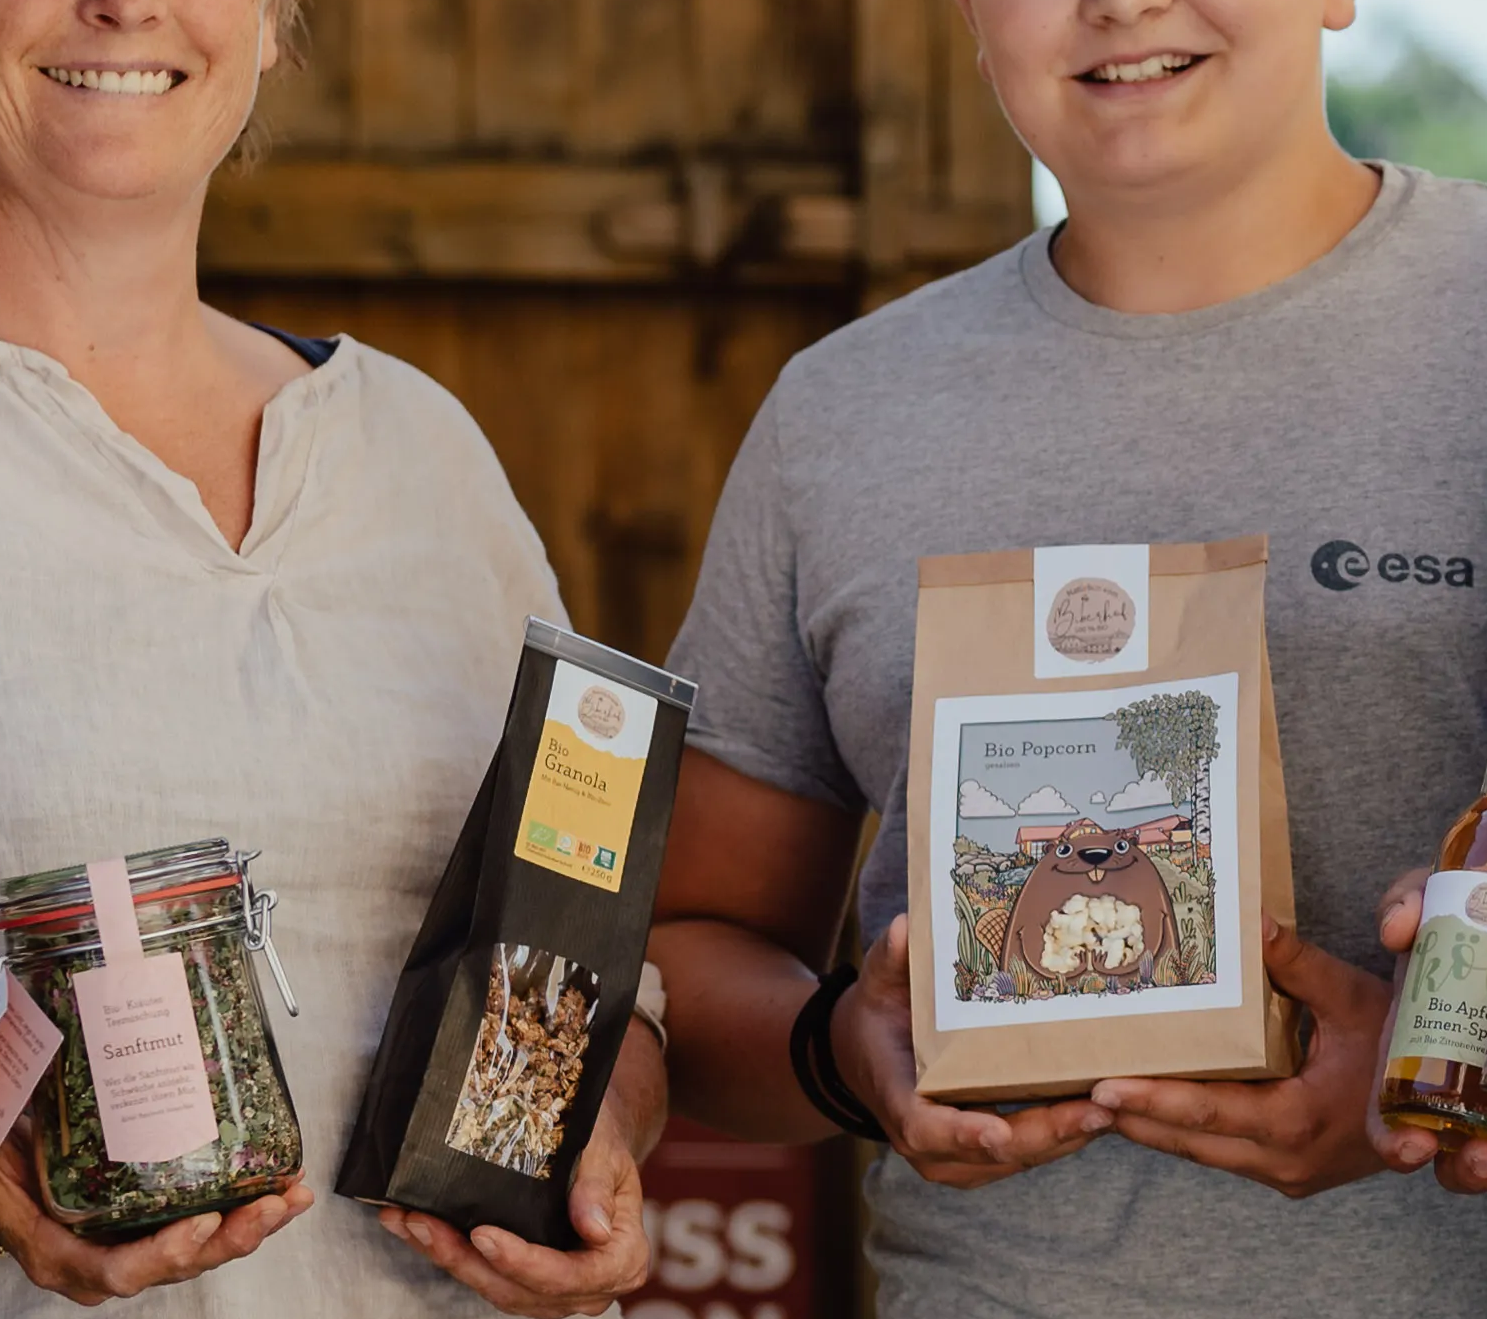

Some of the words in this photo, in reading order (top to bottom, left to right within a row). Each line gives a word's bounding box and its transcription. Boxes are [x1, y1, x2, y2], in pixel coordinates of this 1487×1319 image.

[1377, 553, 1474, 588] esa
[548, 737, 569, 757] Bio
[984, 742, 1015, 758] Bio
[1021, 741, 1097, 759] Popcorn
[544, 753, 608, 792] Granola
[1428, 997, 1452, 1012] Bio
[103, 1033, 184, 1060] Sanftmut
